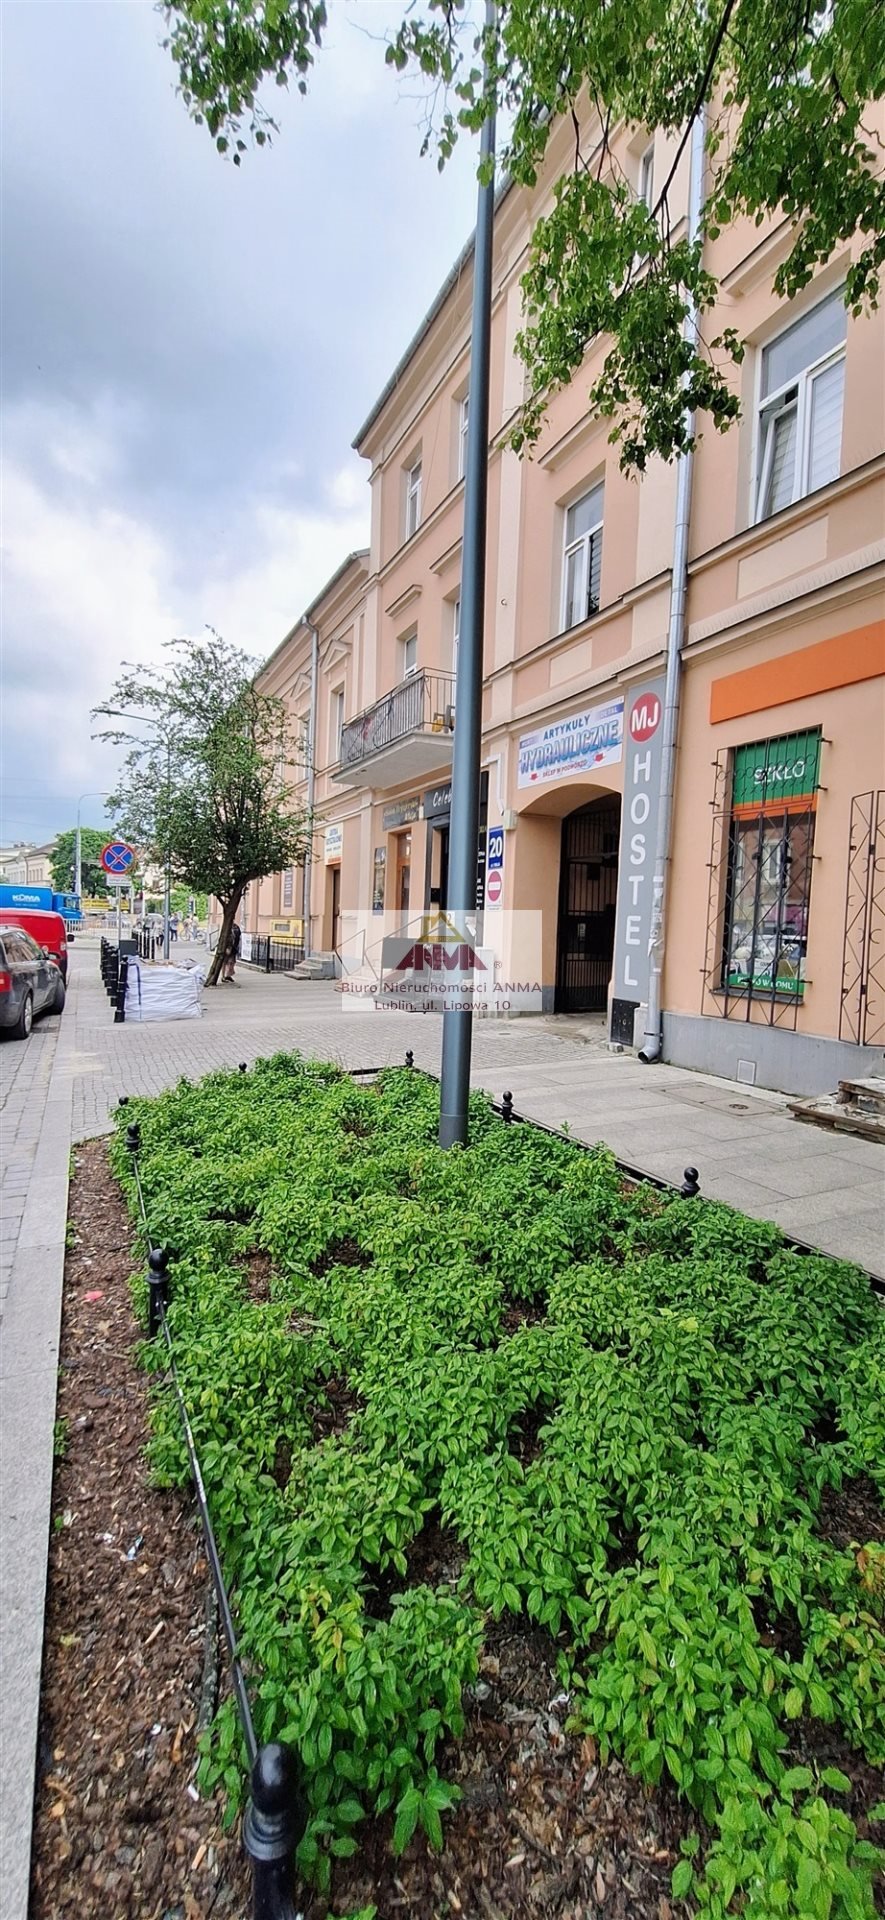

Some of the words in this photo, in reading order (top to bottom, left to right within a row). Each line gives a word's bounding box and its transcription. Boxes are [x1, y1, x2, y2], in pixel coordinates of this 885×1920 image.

[543, 714, 591, 740] ARTYKUŁY
[631, 702, 659, 733] MJ
[519, 719, 620, 774] HYDRAULICZNE
[754, 760, 805, 785] SZKŁO
[489, 836, 503, 859] 20
[624, 750, 651, 987] HOSTEL
[762, 978, 770, 986] W
